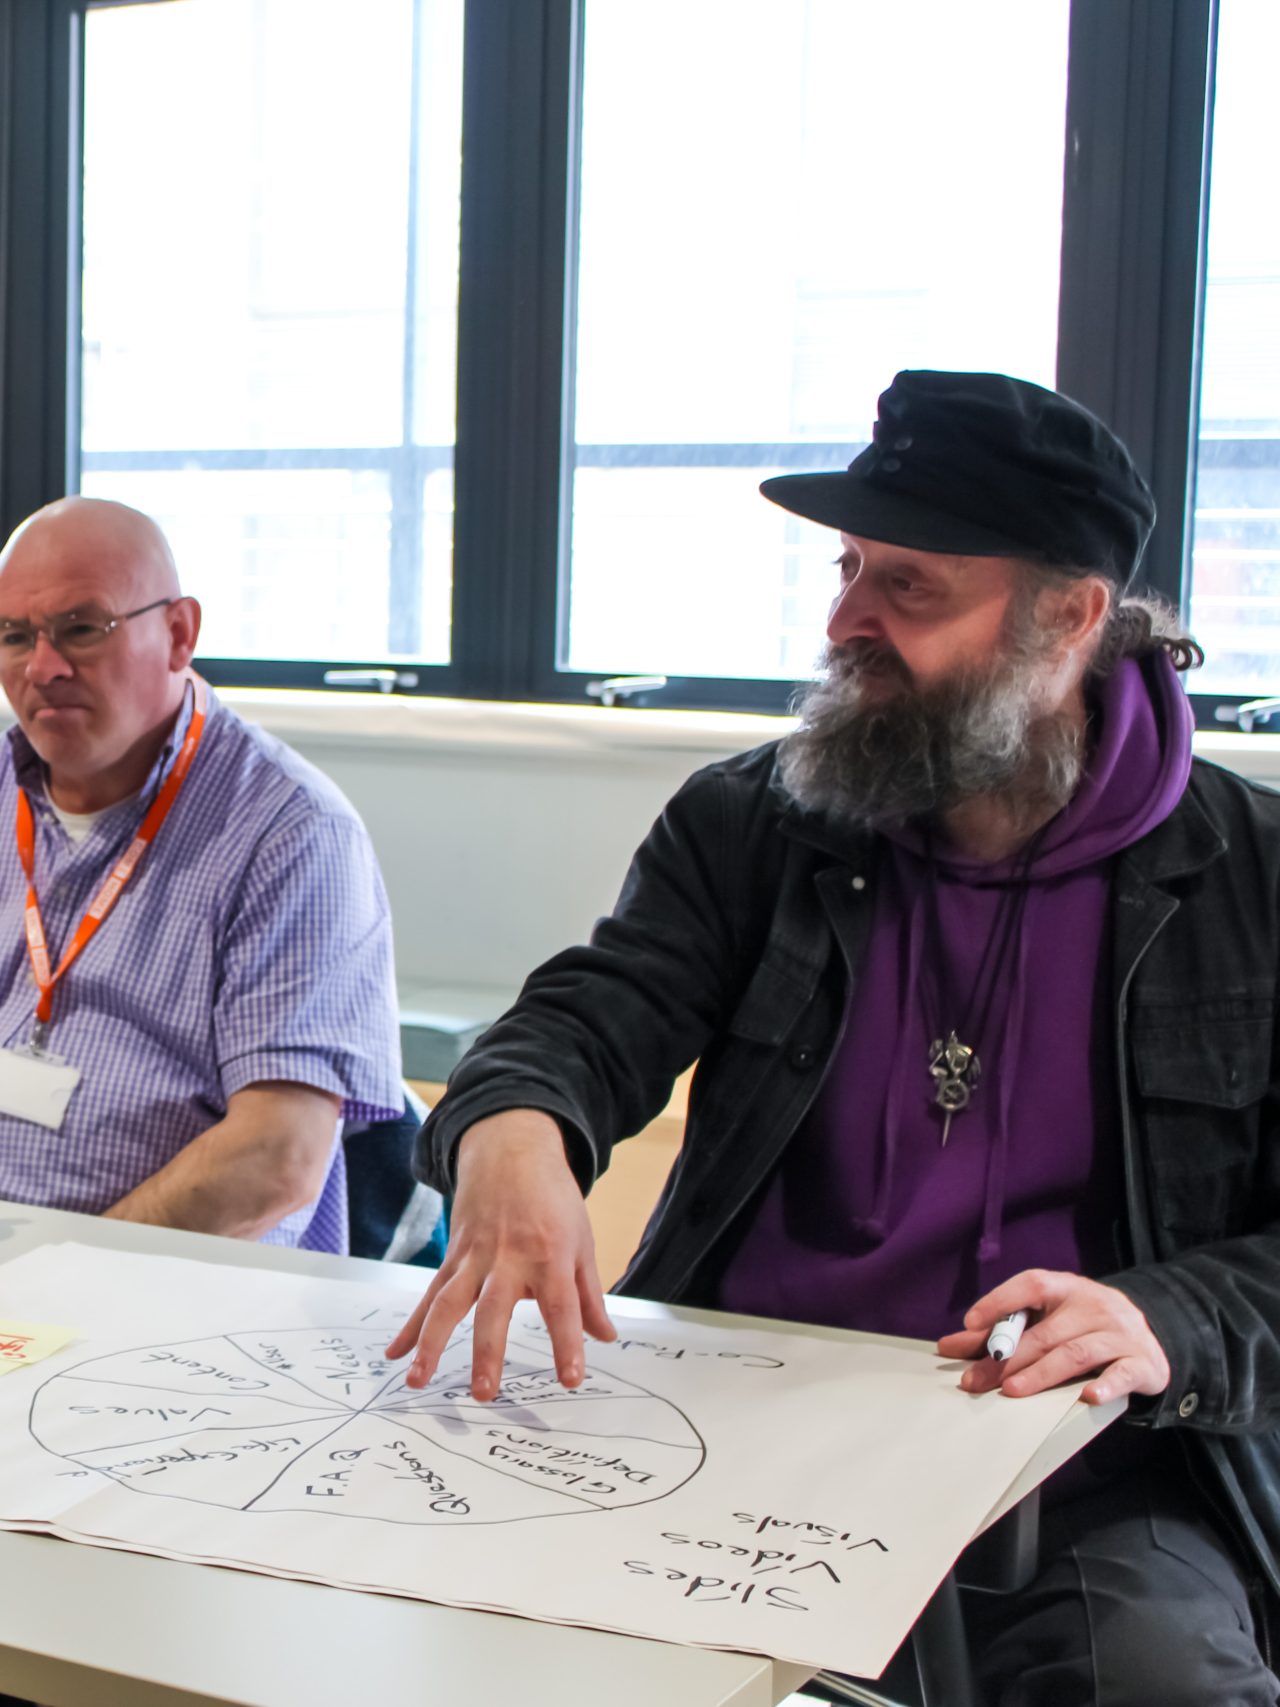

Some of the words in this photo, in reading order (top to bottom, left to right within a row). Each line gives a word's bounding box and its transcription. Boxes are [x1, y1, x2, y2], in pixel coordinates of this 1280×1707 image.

[140, 1352, 270, 1391] Content
[69, 1406, 231, 1422] Values
[374, 1440, 471, 1516] Questions
[483, 1429, 656, 1485] Definitions
[488, 1445, 617, 1495] Glossary
[660, 1532, 841, 1584] Videos
[732, 1512, 889, 1553] Visuals
[623, 1560, 810, 1612] Slides
